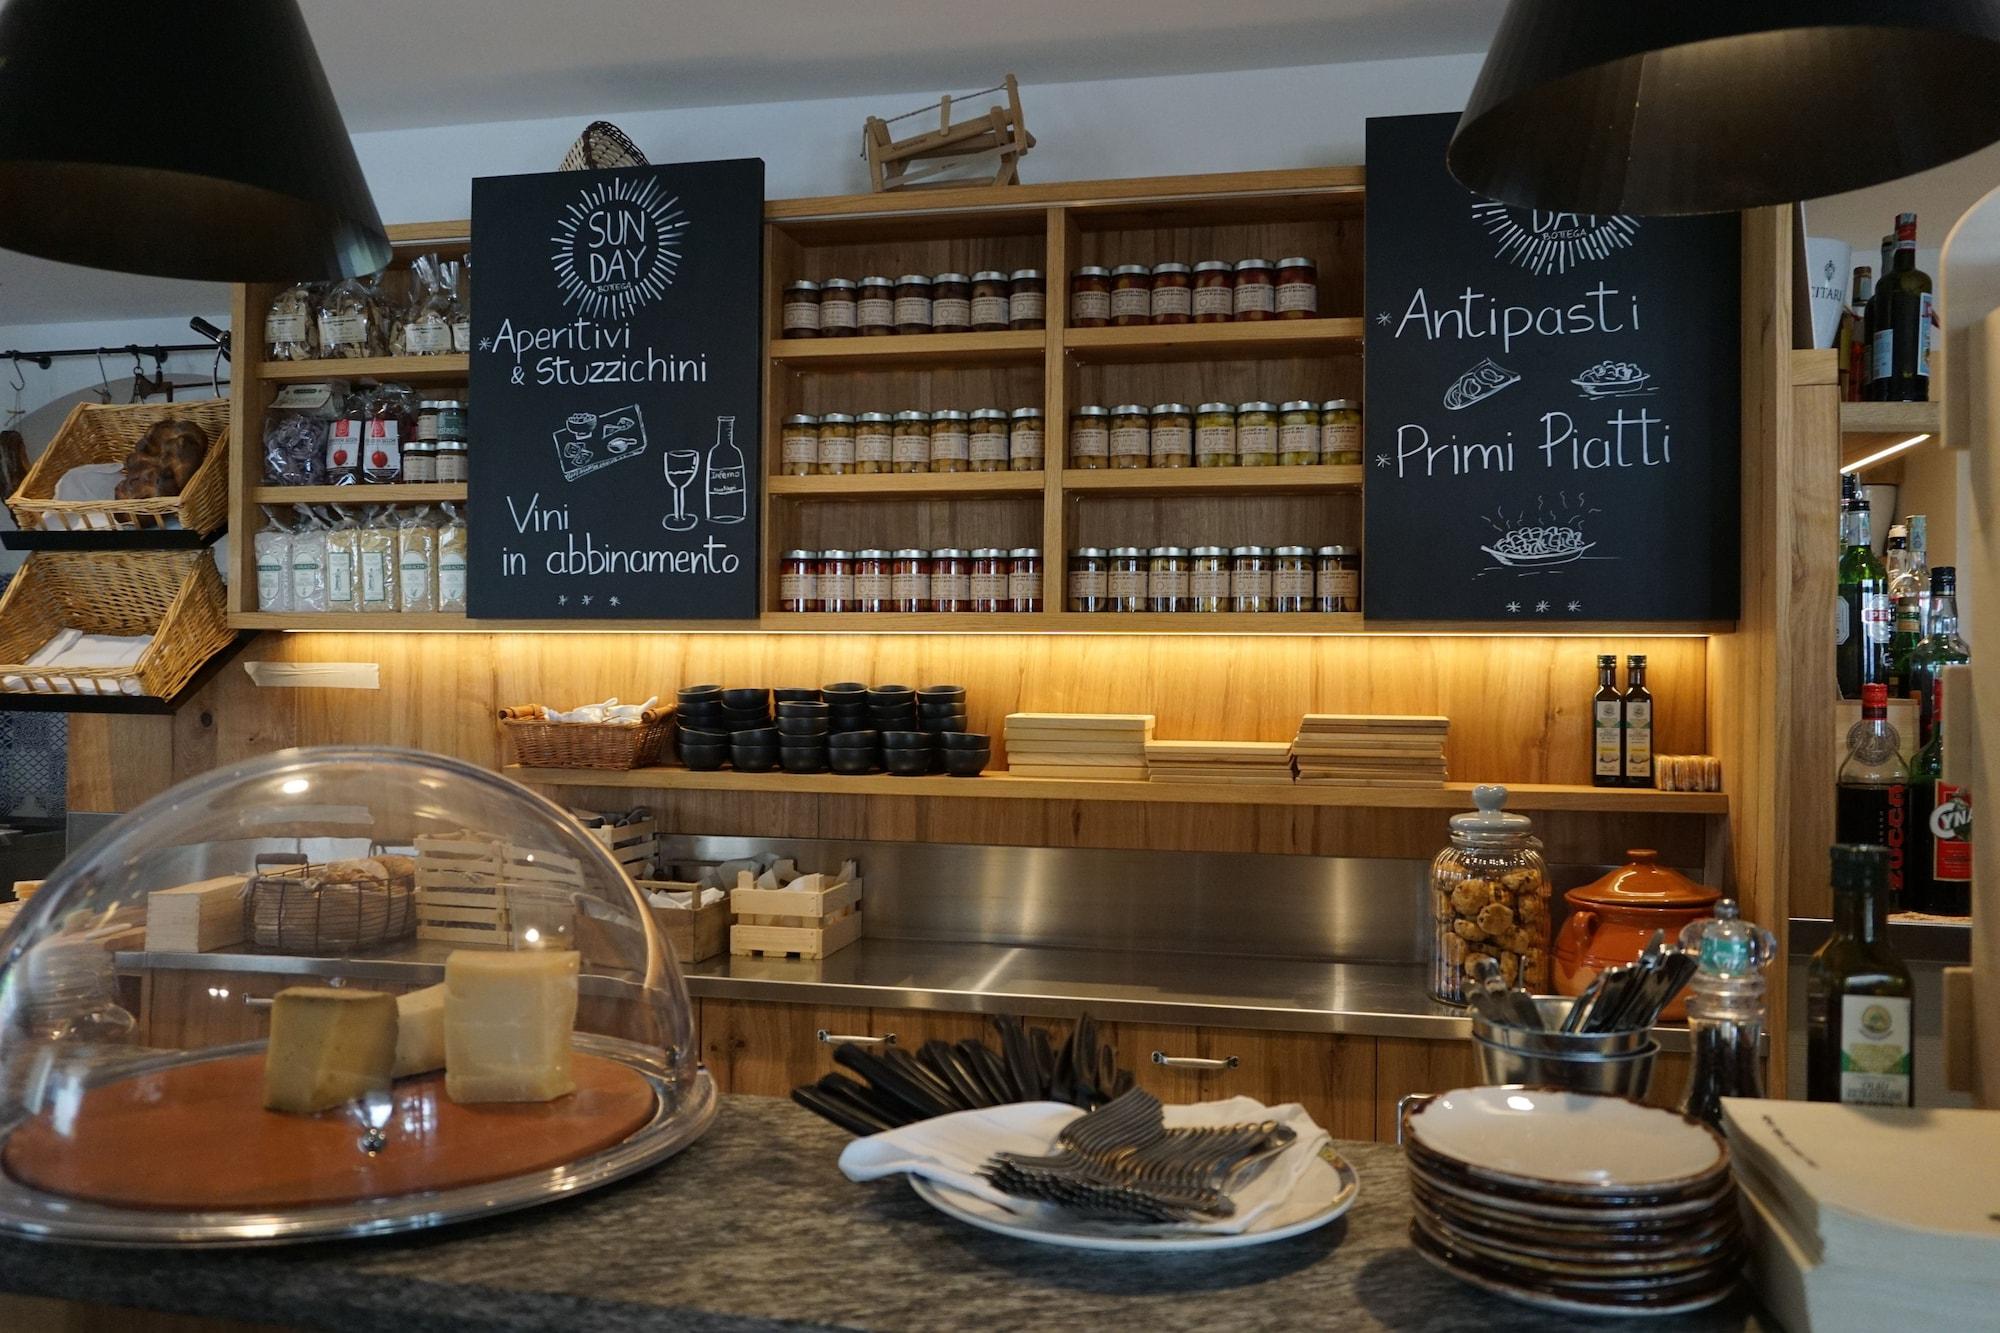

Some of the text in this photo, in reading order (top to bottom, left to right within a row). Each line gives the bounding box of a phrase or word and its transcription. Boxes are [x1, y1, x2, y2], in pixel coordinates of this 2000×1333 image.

[588, 210, 645, 248] SUN
[590, 246, 647, 284] DAY
[1394, 281, 1639, 354] Antipasti
[491, 317, 630, 364] Aperitivi
[510, 346, 707, 386] & Stuzzichini
[1397, 424, 1514, 479] Primi
[1538, 408, 1671, 470] Piatti
[506, 492, 569, 534] Vini
[502, 532, 740, 577] in abbinamento
